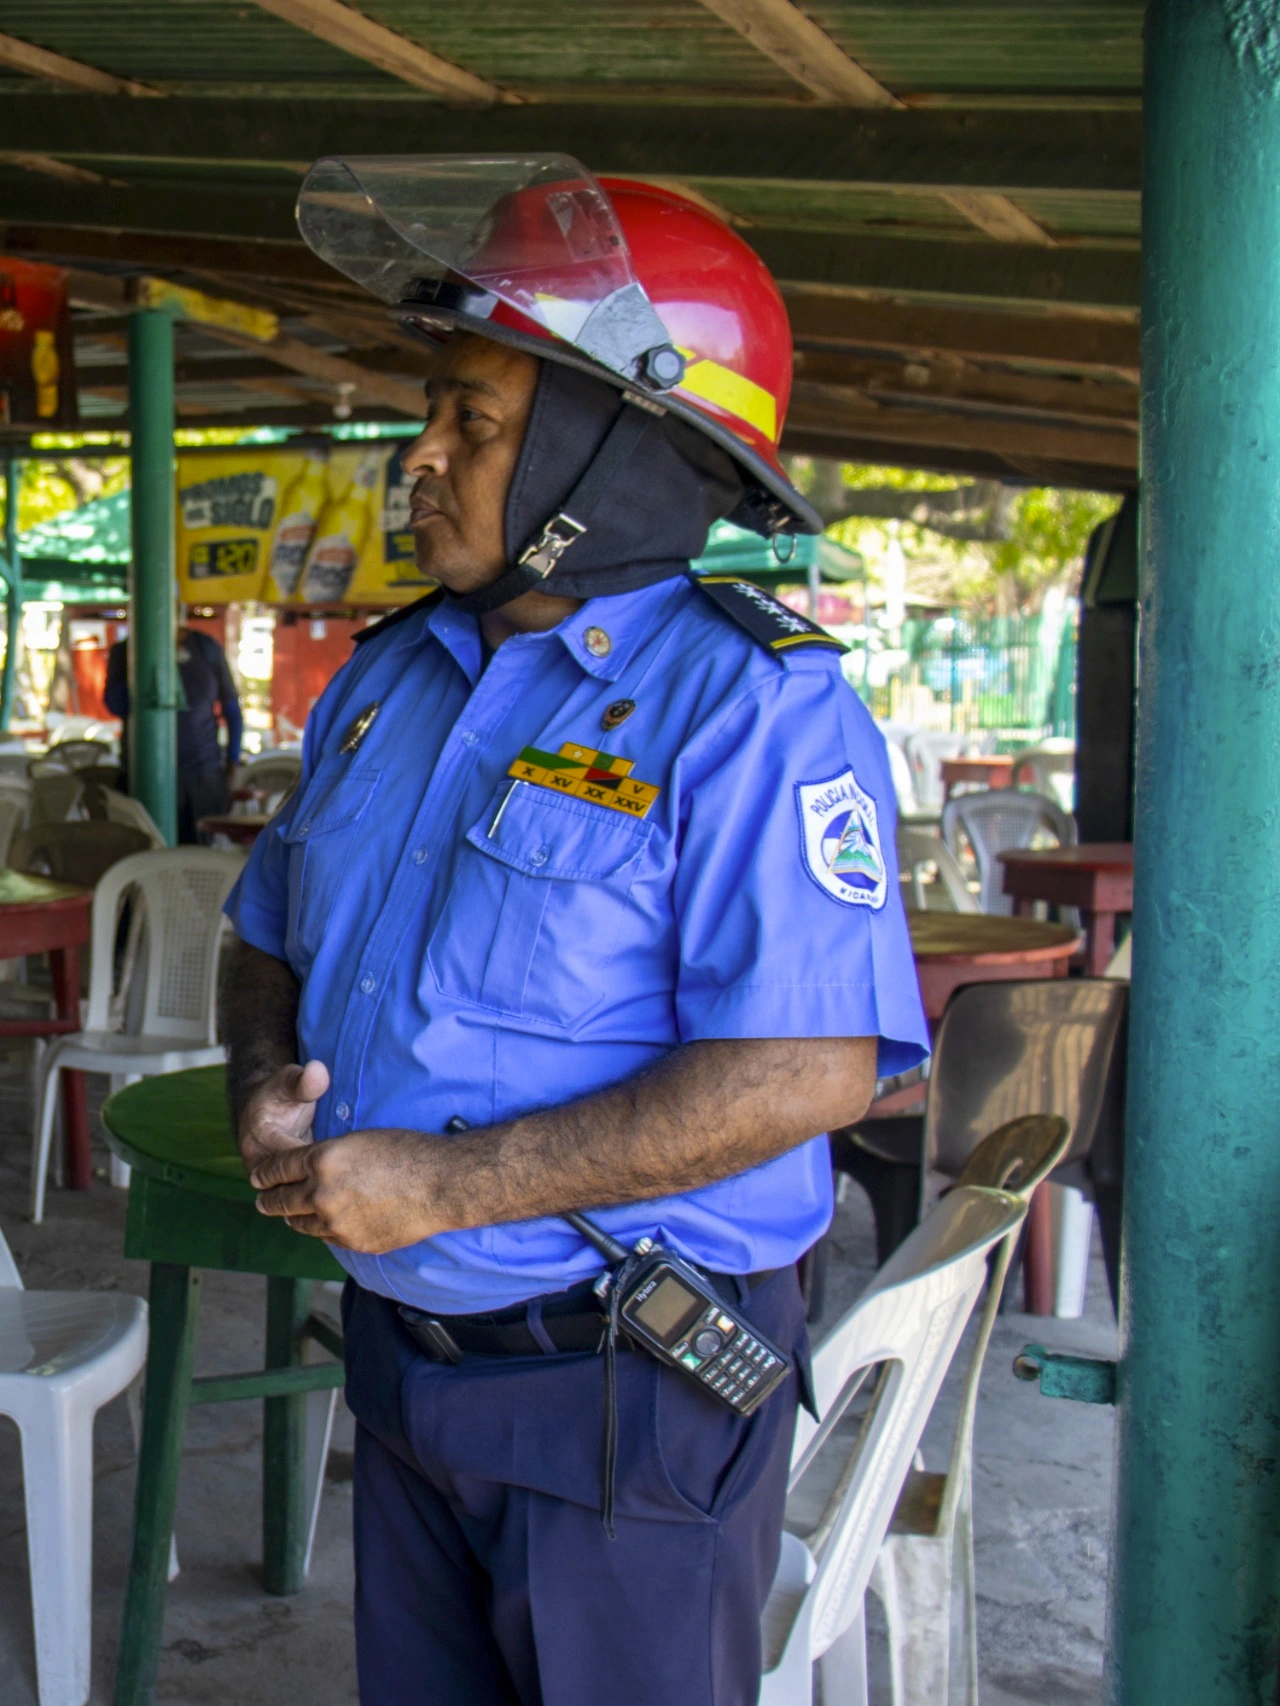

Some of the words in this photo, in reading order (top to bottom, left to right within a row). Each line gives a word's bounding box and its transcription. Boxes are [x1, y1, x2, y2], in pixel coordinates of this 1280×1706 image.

[522, 766, 536, 778] X
[551, 775, 573, 788] XV
[584, 786, 607, 800] XX
[614, 796, 646, 812] XXV
[633, 784, 645, 795] V
[635, 1281, 657, 1302] Hytera
